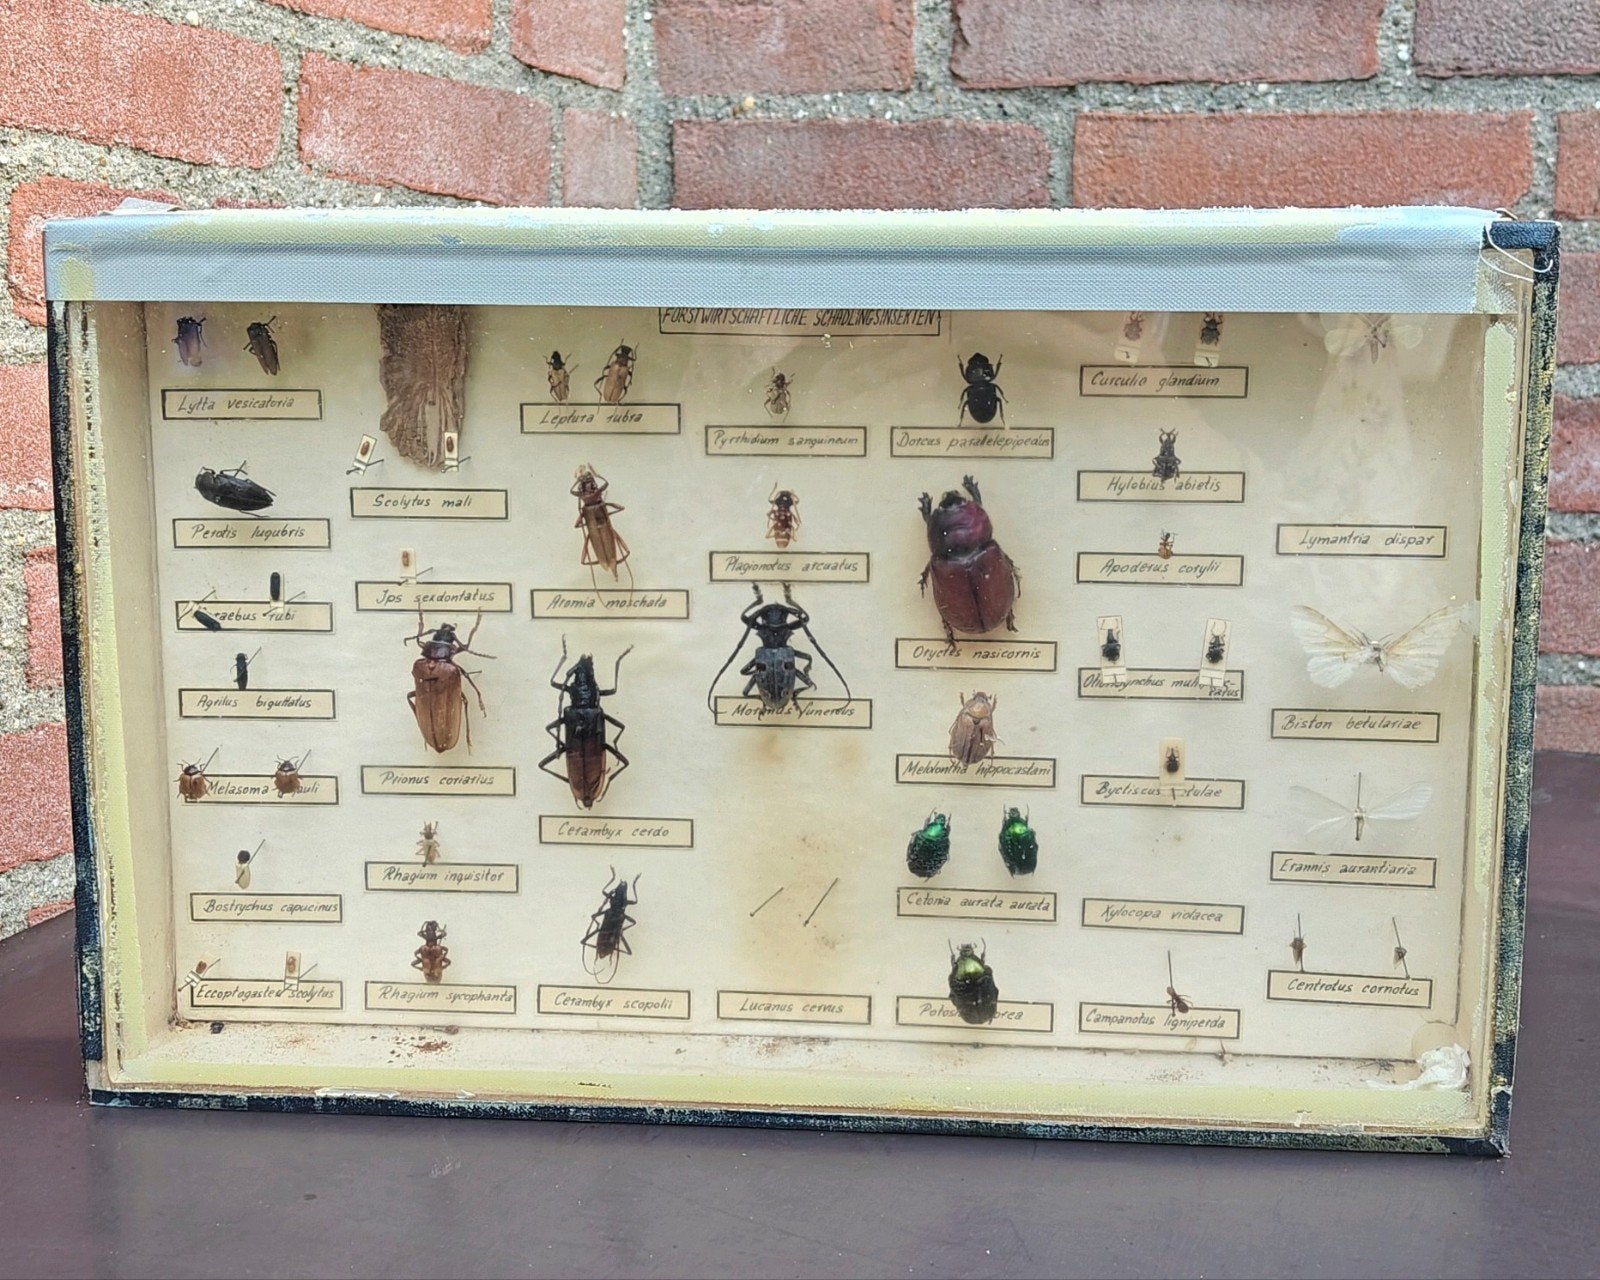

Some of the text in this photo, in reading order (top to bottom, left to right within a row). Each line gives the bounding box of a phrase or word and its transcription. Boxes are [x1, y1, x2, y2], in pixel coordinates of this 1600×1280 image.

[1156, 371, 1219, 392] glandium
[227, 394, 294, 409] vesicatoria
[540, 410, 643, 428] Leptura rubra
[788, 437, 858, 449] sanguineum
[897, 432, 941, 447] Dorcus
[1107, 475, 1221, 496] Hylobius abietis
[373, 494, 473, 509] Scolytus mali
[251, 524, 305, 543] lugubris
[1299, 530, 1435, 549] Lymantria dispar
[725, 556, 859, 575] Plagionotus arcuatus
[1100, 559, 1169, 577] Apoderus
[547, 595, 595, 610] Aromia
[972, 648, 1042, 659] nasicornis
[197, 694, 238, 711] Agrilus
[1281, 715, 1422, 730] Biston betulariae
[380, 771, 429, 785] Prionus
[207, 781, 269, 795] Melasoma
[558, 821, 669, 839] Cerambyx cerdo
[1279, 858, 1416, 875] Erannis aurantiaria
[382, 866, 504, 885] Rhagium inquisitor
[203, 899, 338, 916] Bostrychus capucinus
[906, 892, 1050, 912] Cetonia aurata aurata
[1101, 904, 1223, 922] Xylocopa violacea
[1287, 978, 1353, 993] Centrotus
[378, 986, 440, 1003] Rhagium
[554, 992, 674, 1012] Cerambyx scopolii
[739, 998, 844, 1013] Lucanus cervus
